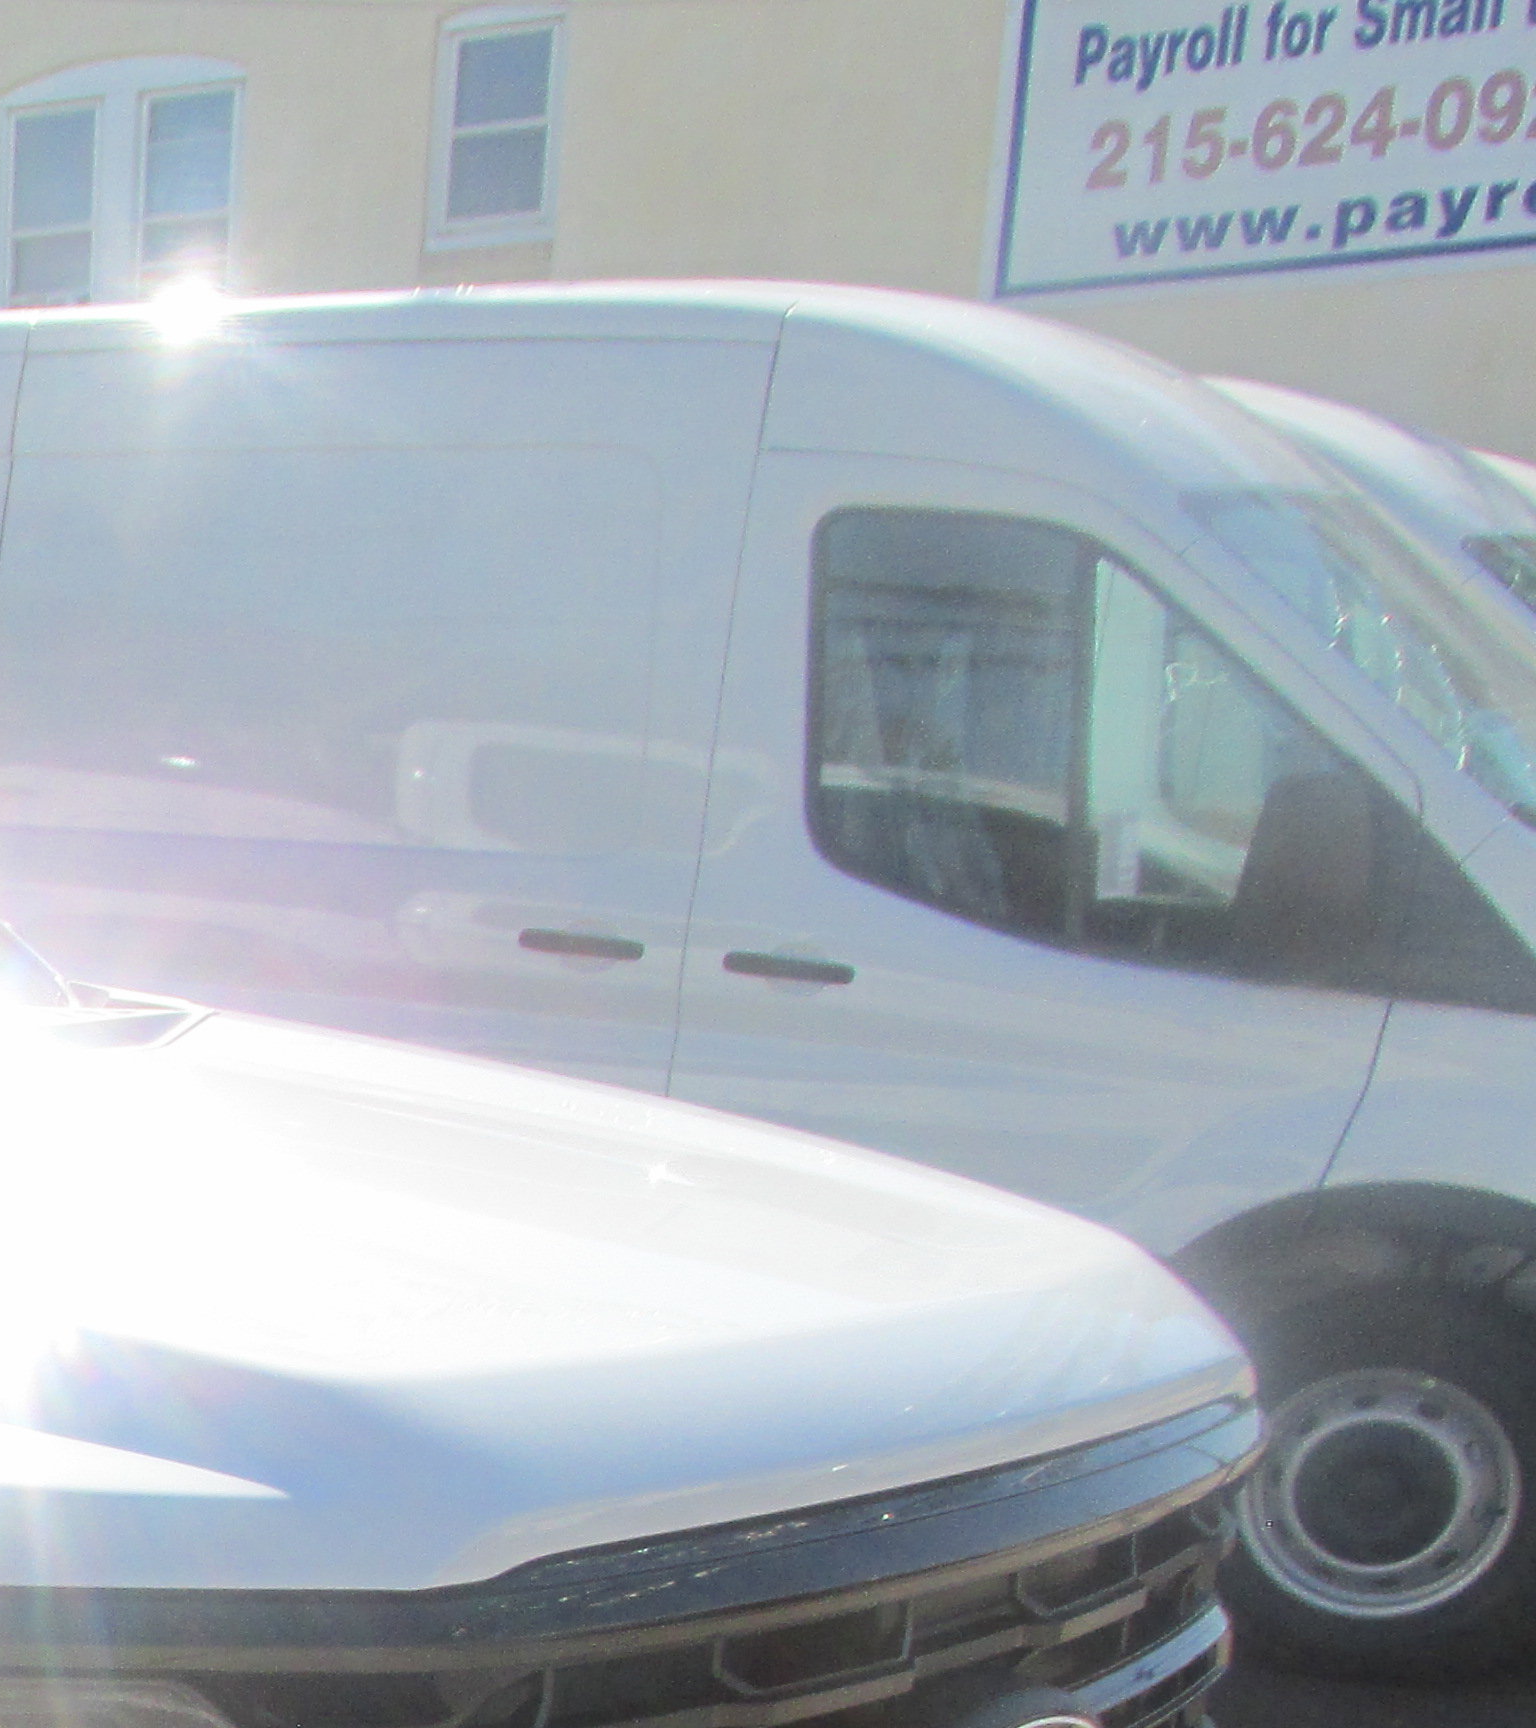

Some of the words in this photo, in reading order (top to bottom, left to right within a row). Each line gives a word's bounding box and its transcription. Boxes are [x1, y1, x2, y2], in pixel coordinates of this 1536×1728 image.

[1074, 4, 1249, 92] Payroll
[1264, 0, 1338, 61] for
[1084, 68, 1536, 191] 215-624-09
